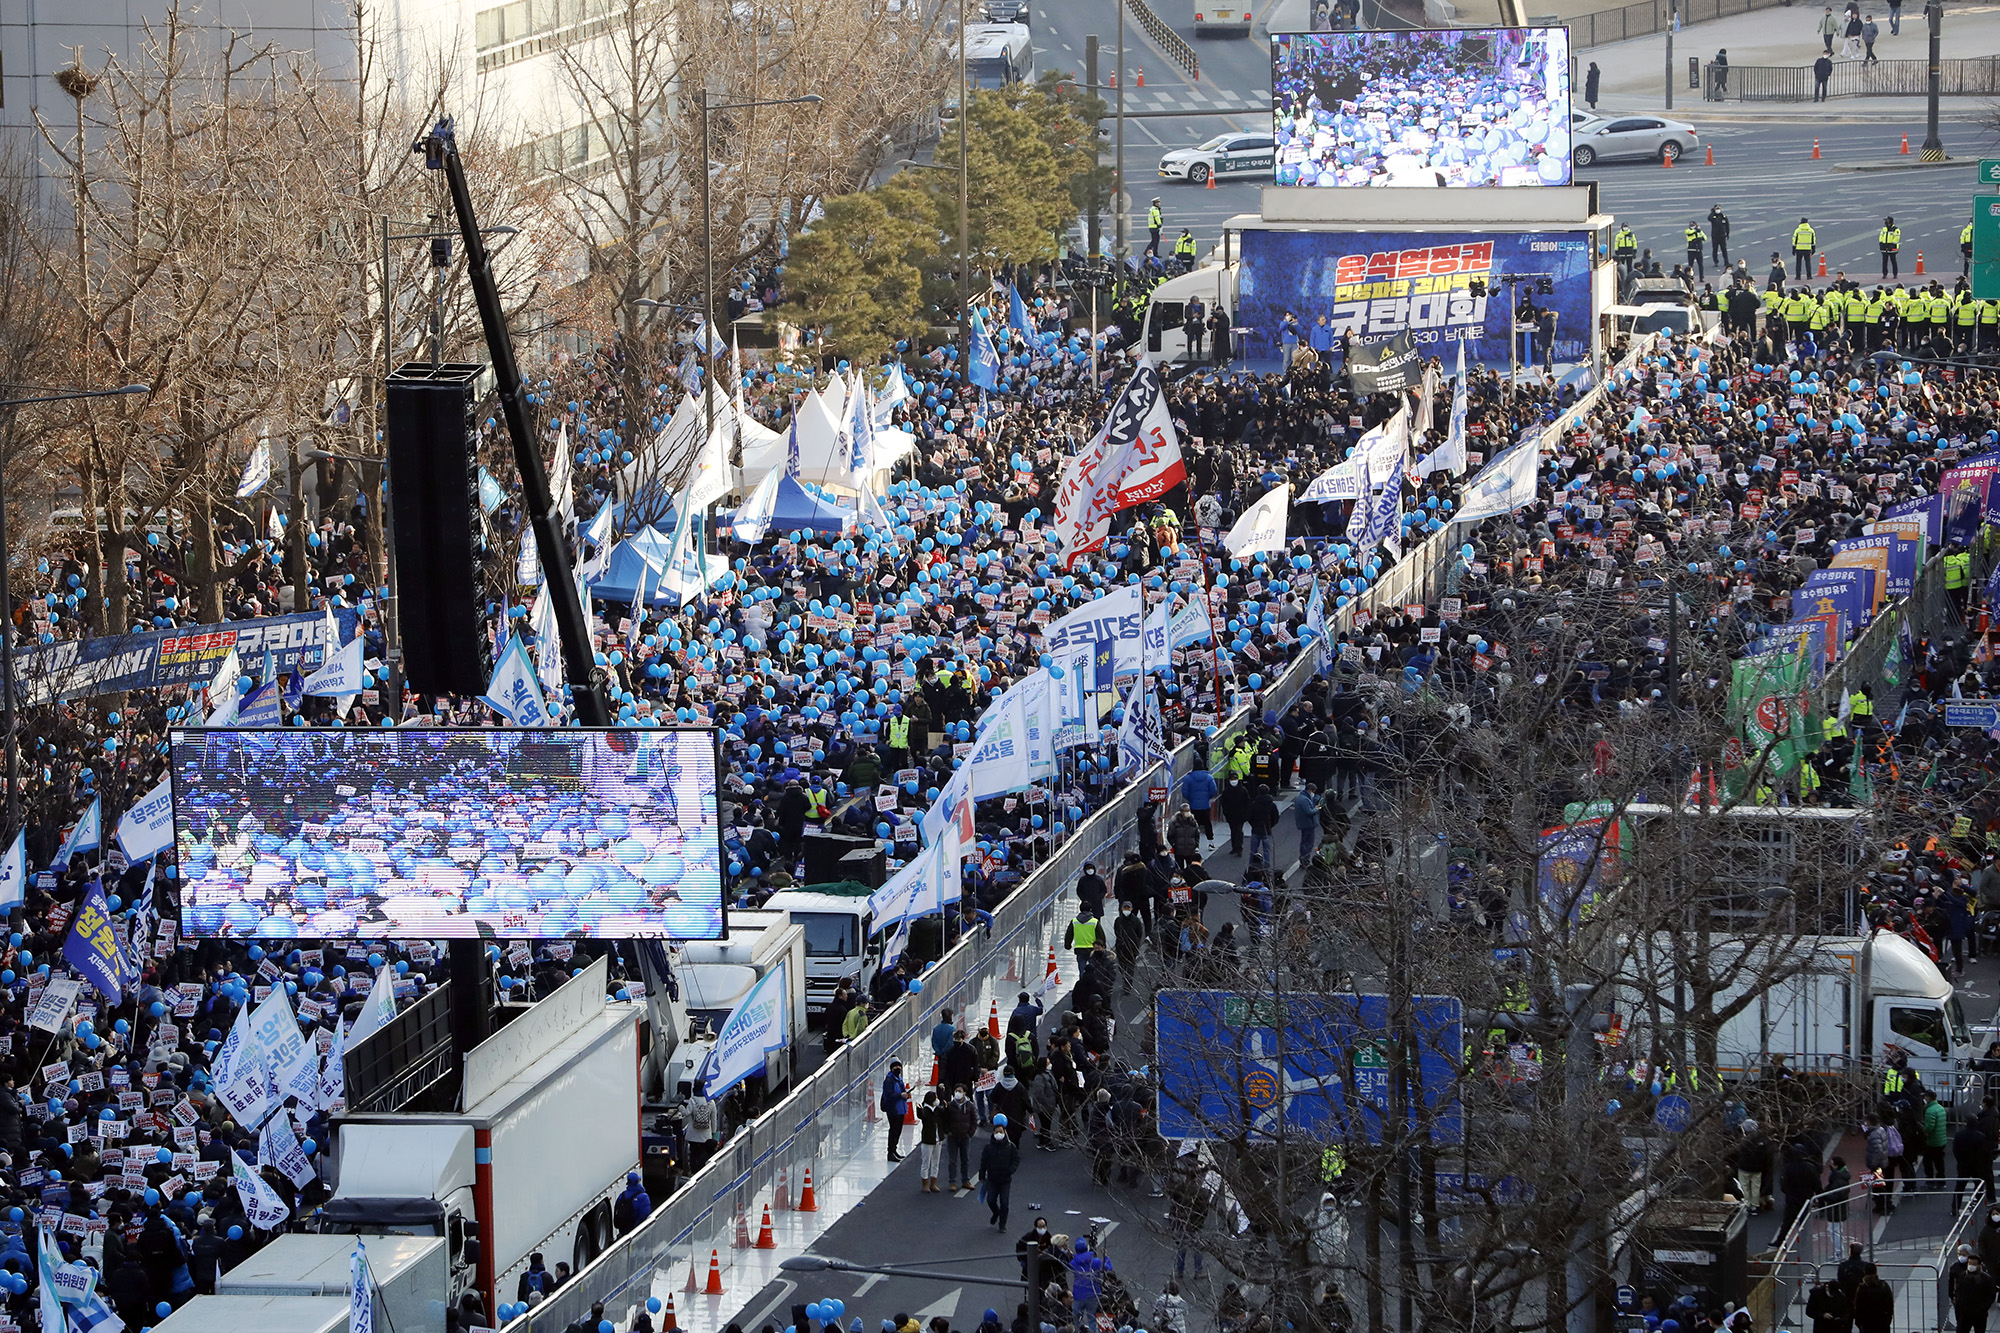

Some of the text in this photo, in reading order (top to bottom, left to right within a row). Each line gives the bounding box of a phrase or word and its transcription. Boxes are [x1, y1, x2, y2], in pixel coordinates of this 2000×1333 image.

[1530, 241, 1586, 252] 더불어민주당
[1334, 240, 1495, 285] 윤석열정권
[1334, 271, 1490, 303] 민생파탄 검사독
[1330, 289, 1489, 337] 규탄대회
[1444, 325, 1485, 342] 남대문
[161, 630, 237, 655] 윤석열정권
[87, 951, 121, 992] 지역위원회
[83, 1082, 101, 1090] 검!
